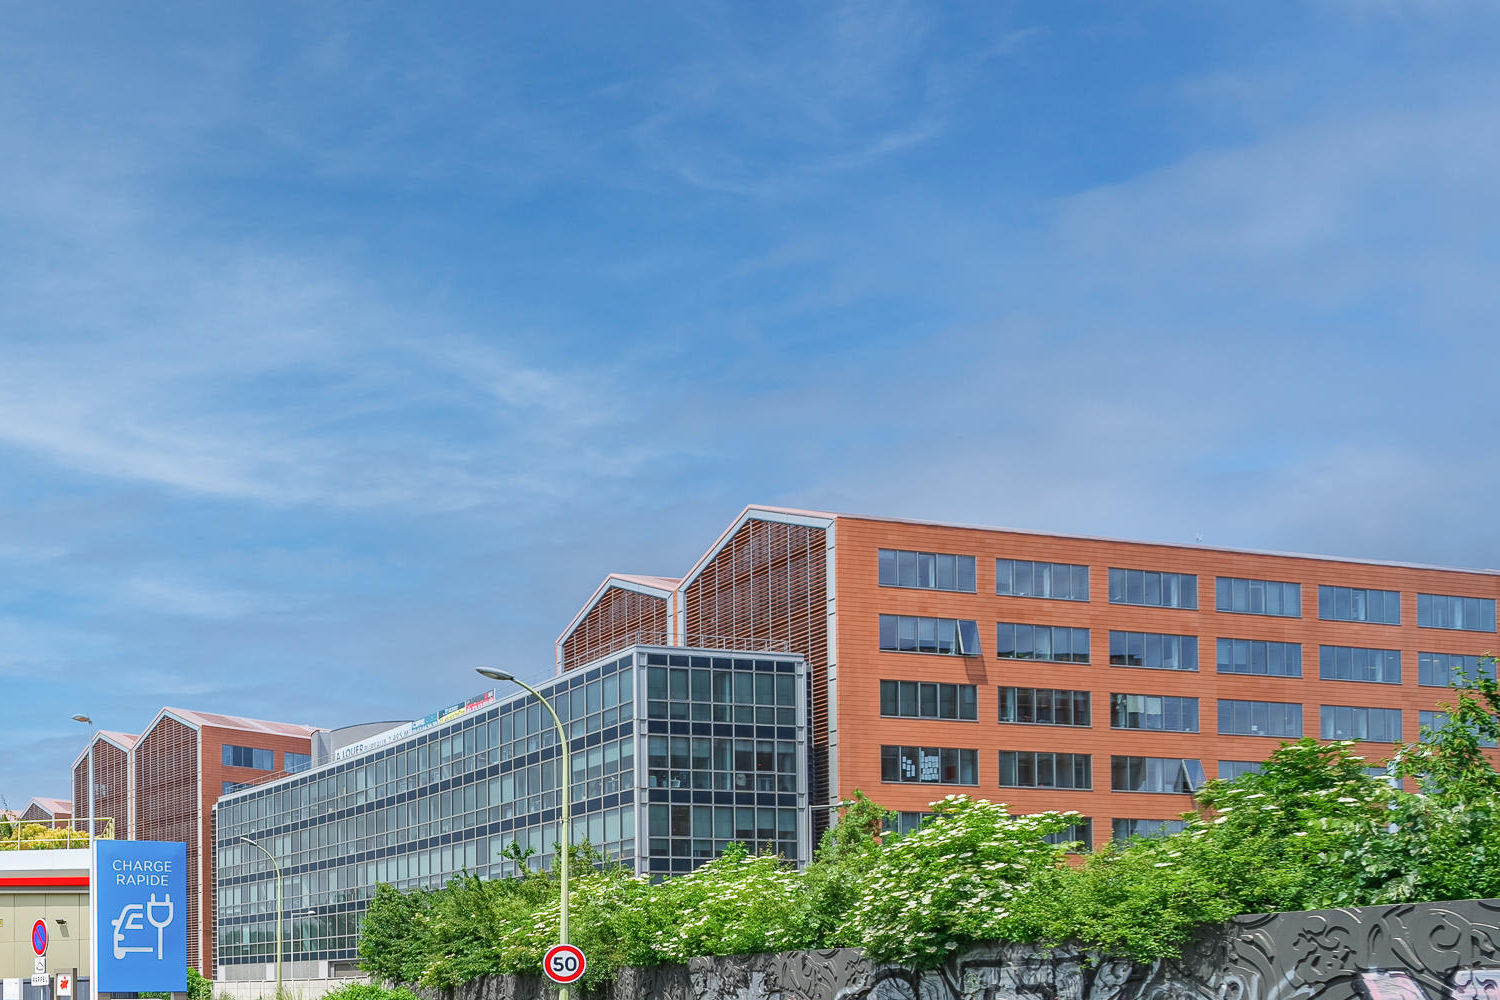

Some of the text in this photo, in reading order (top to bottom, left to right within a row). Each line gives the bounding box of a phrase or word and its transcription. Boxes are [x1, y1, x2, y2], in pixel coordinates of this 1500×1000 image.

[112, 859, 173, 873] CHARGE
[116, 874, 169, 886] RAPIDE
[553, 956, 578, 972] 50
